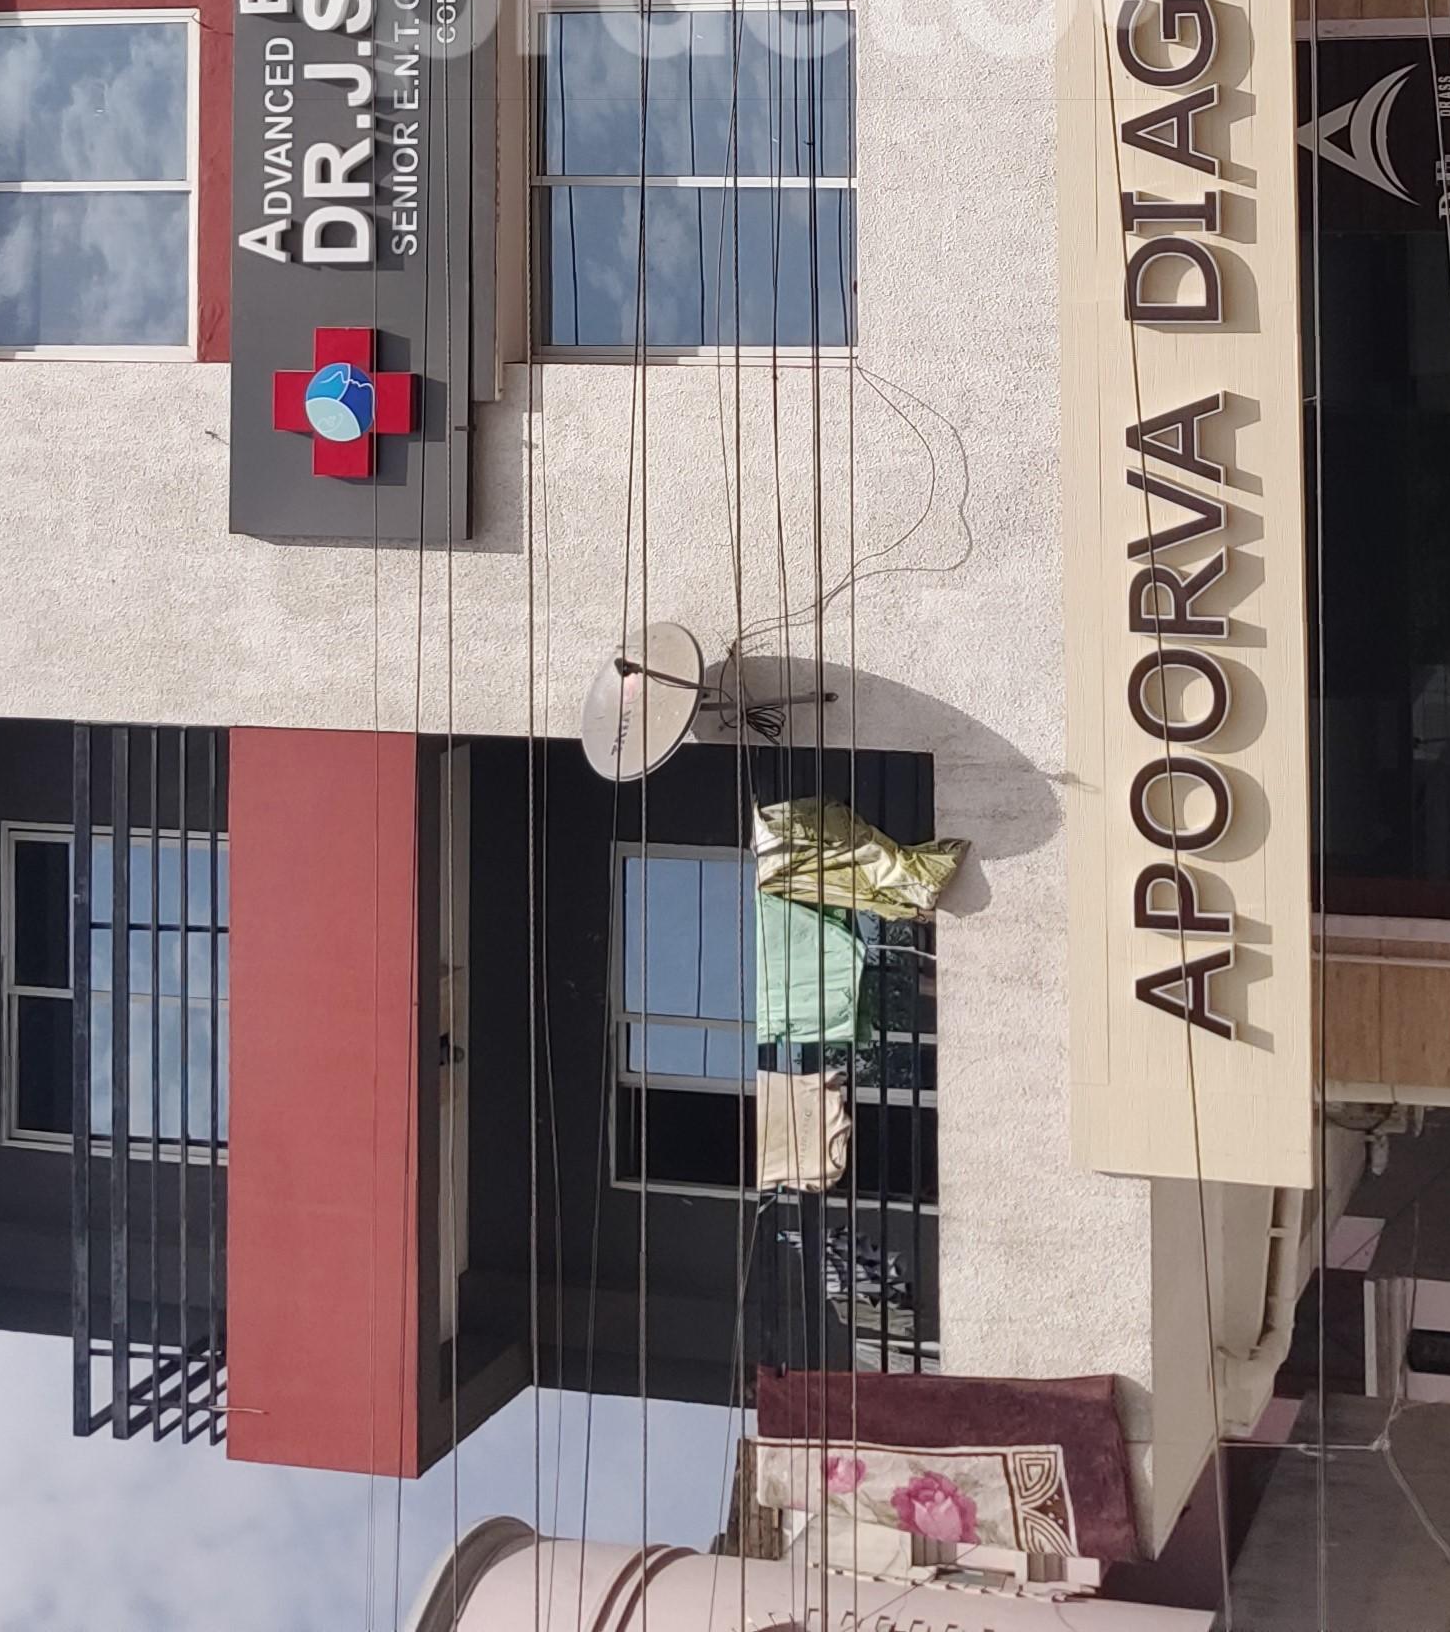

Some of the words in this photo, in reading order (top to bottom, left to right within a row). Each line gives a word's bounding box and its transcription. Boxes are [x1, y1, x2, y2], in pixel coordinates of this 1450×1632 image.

[239, 37, 295, 263] ADVANCED
[393, 17, 421, 110] E.N.T.
[391, 121, 420, 256] SENIOR
[1125, 390, 1237, 1042] APOORVA
